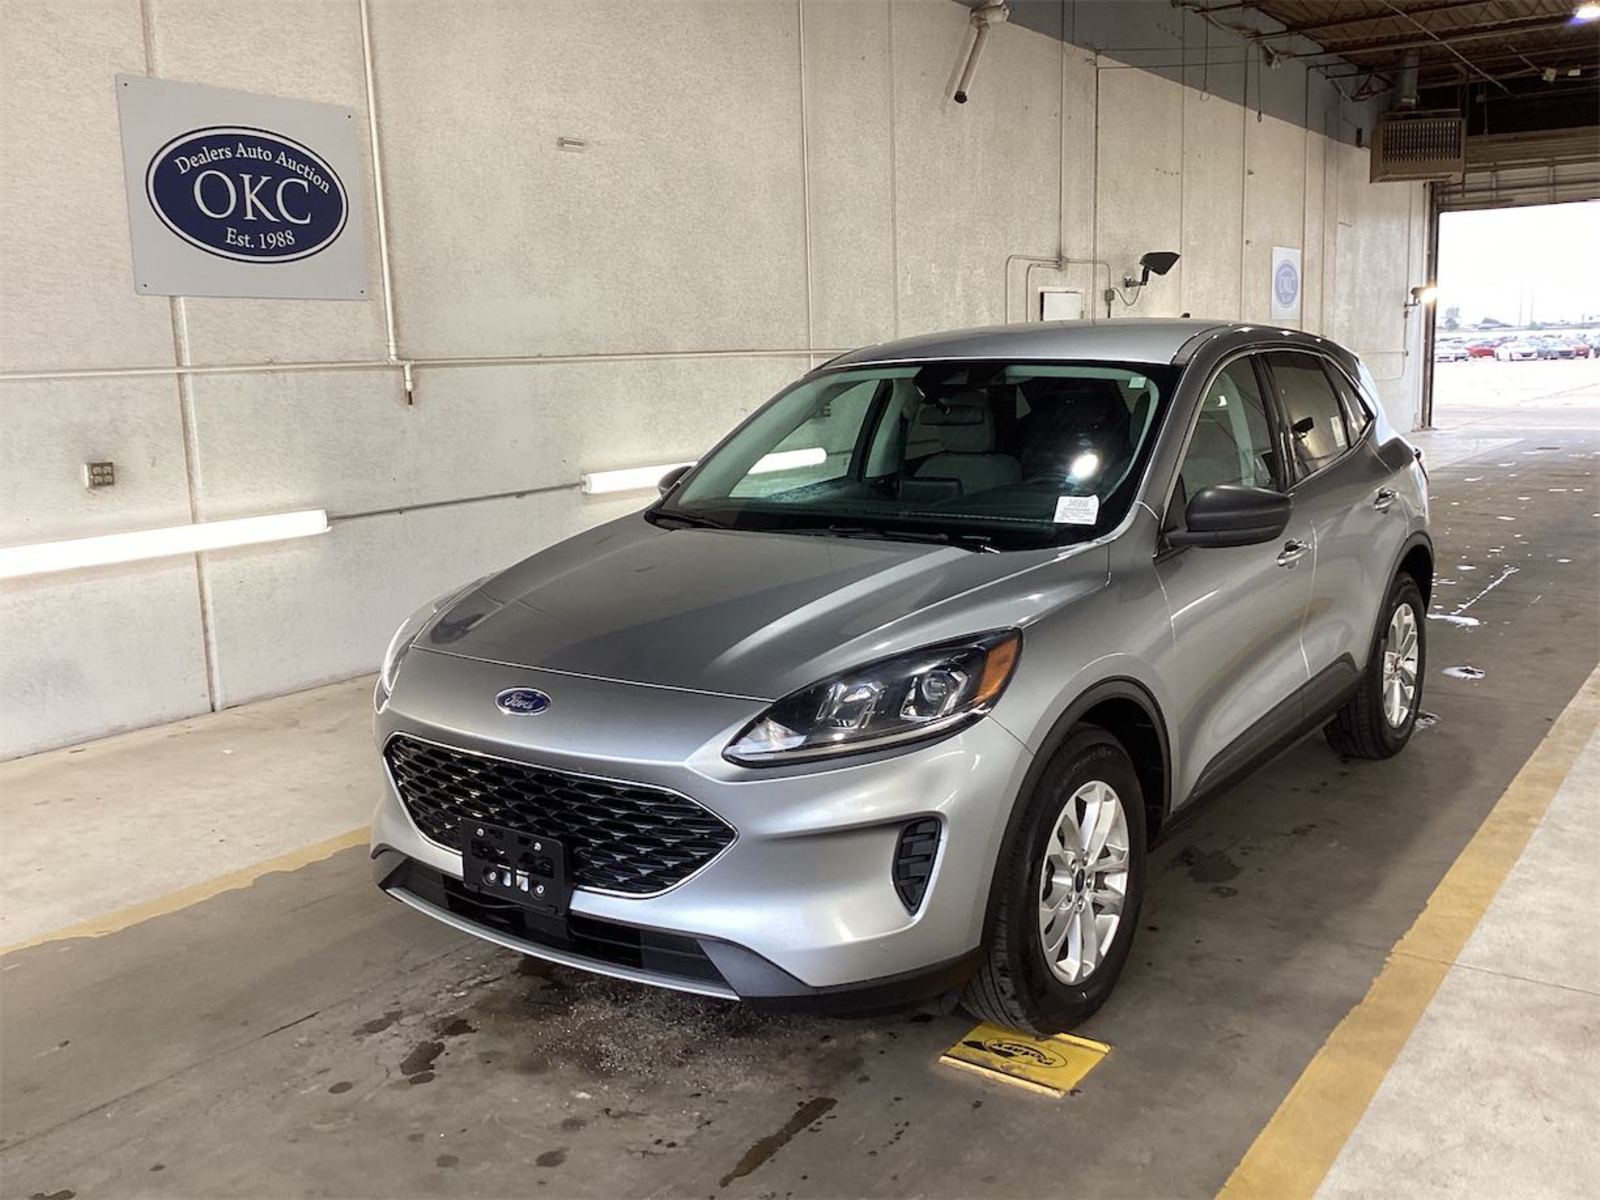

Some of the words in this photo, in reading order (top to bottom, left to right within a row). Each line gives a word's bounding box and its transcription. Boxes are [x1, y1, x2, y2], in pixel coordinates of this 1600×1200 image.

[174, 146, 232, 175] Dealers
[236, 142, 272, 161] Auto
[275, 151, 330, 194] Auction
[193, 170, 311, 224] OKC
[225, 227, 255, 248] Est.
[260, 230, 295, 250] 1988
[503, 691, 541, 710] Ford
